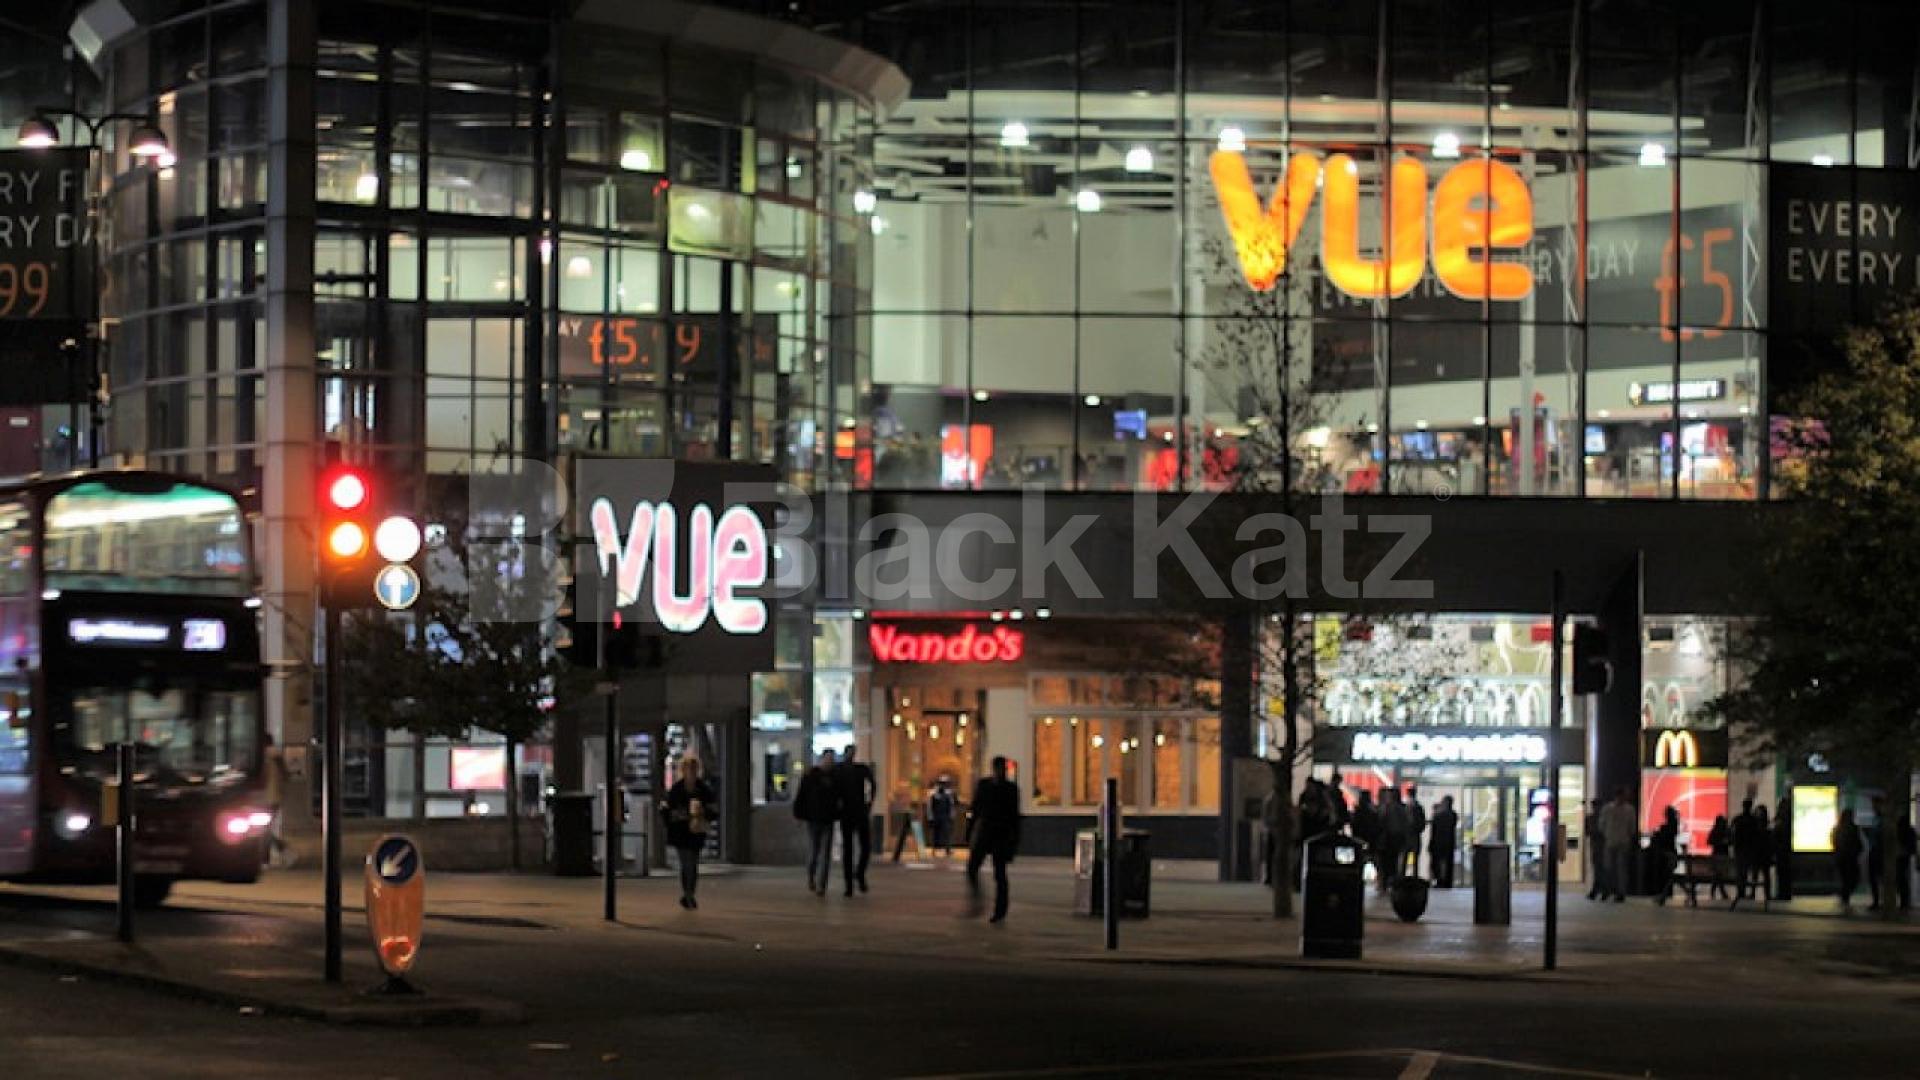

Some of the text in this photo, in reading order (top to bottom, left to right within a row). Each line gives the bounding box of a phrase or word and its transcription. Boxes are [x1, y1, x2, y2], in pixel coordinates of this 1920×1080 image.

[1788, 201, 1901, 238] EVERY
[1655, 227, 1734, 341] £5
[1788, 248, 1901, 285] EVERY
[870, 623, 1024, 664] Nando's
